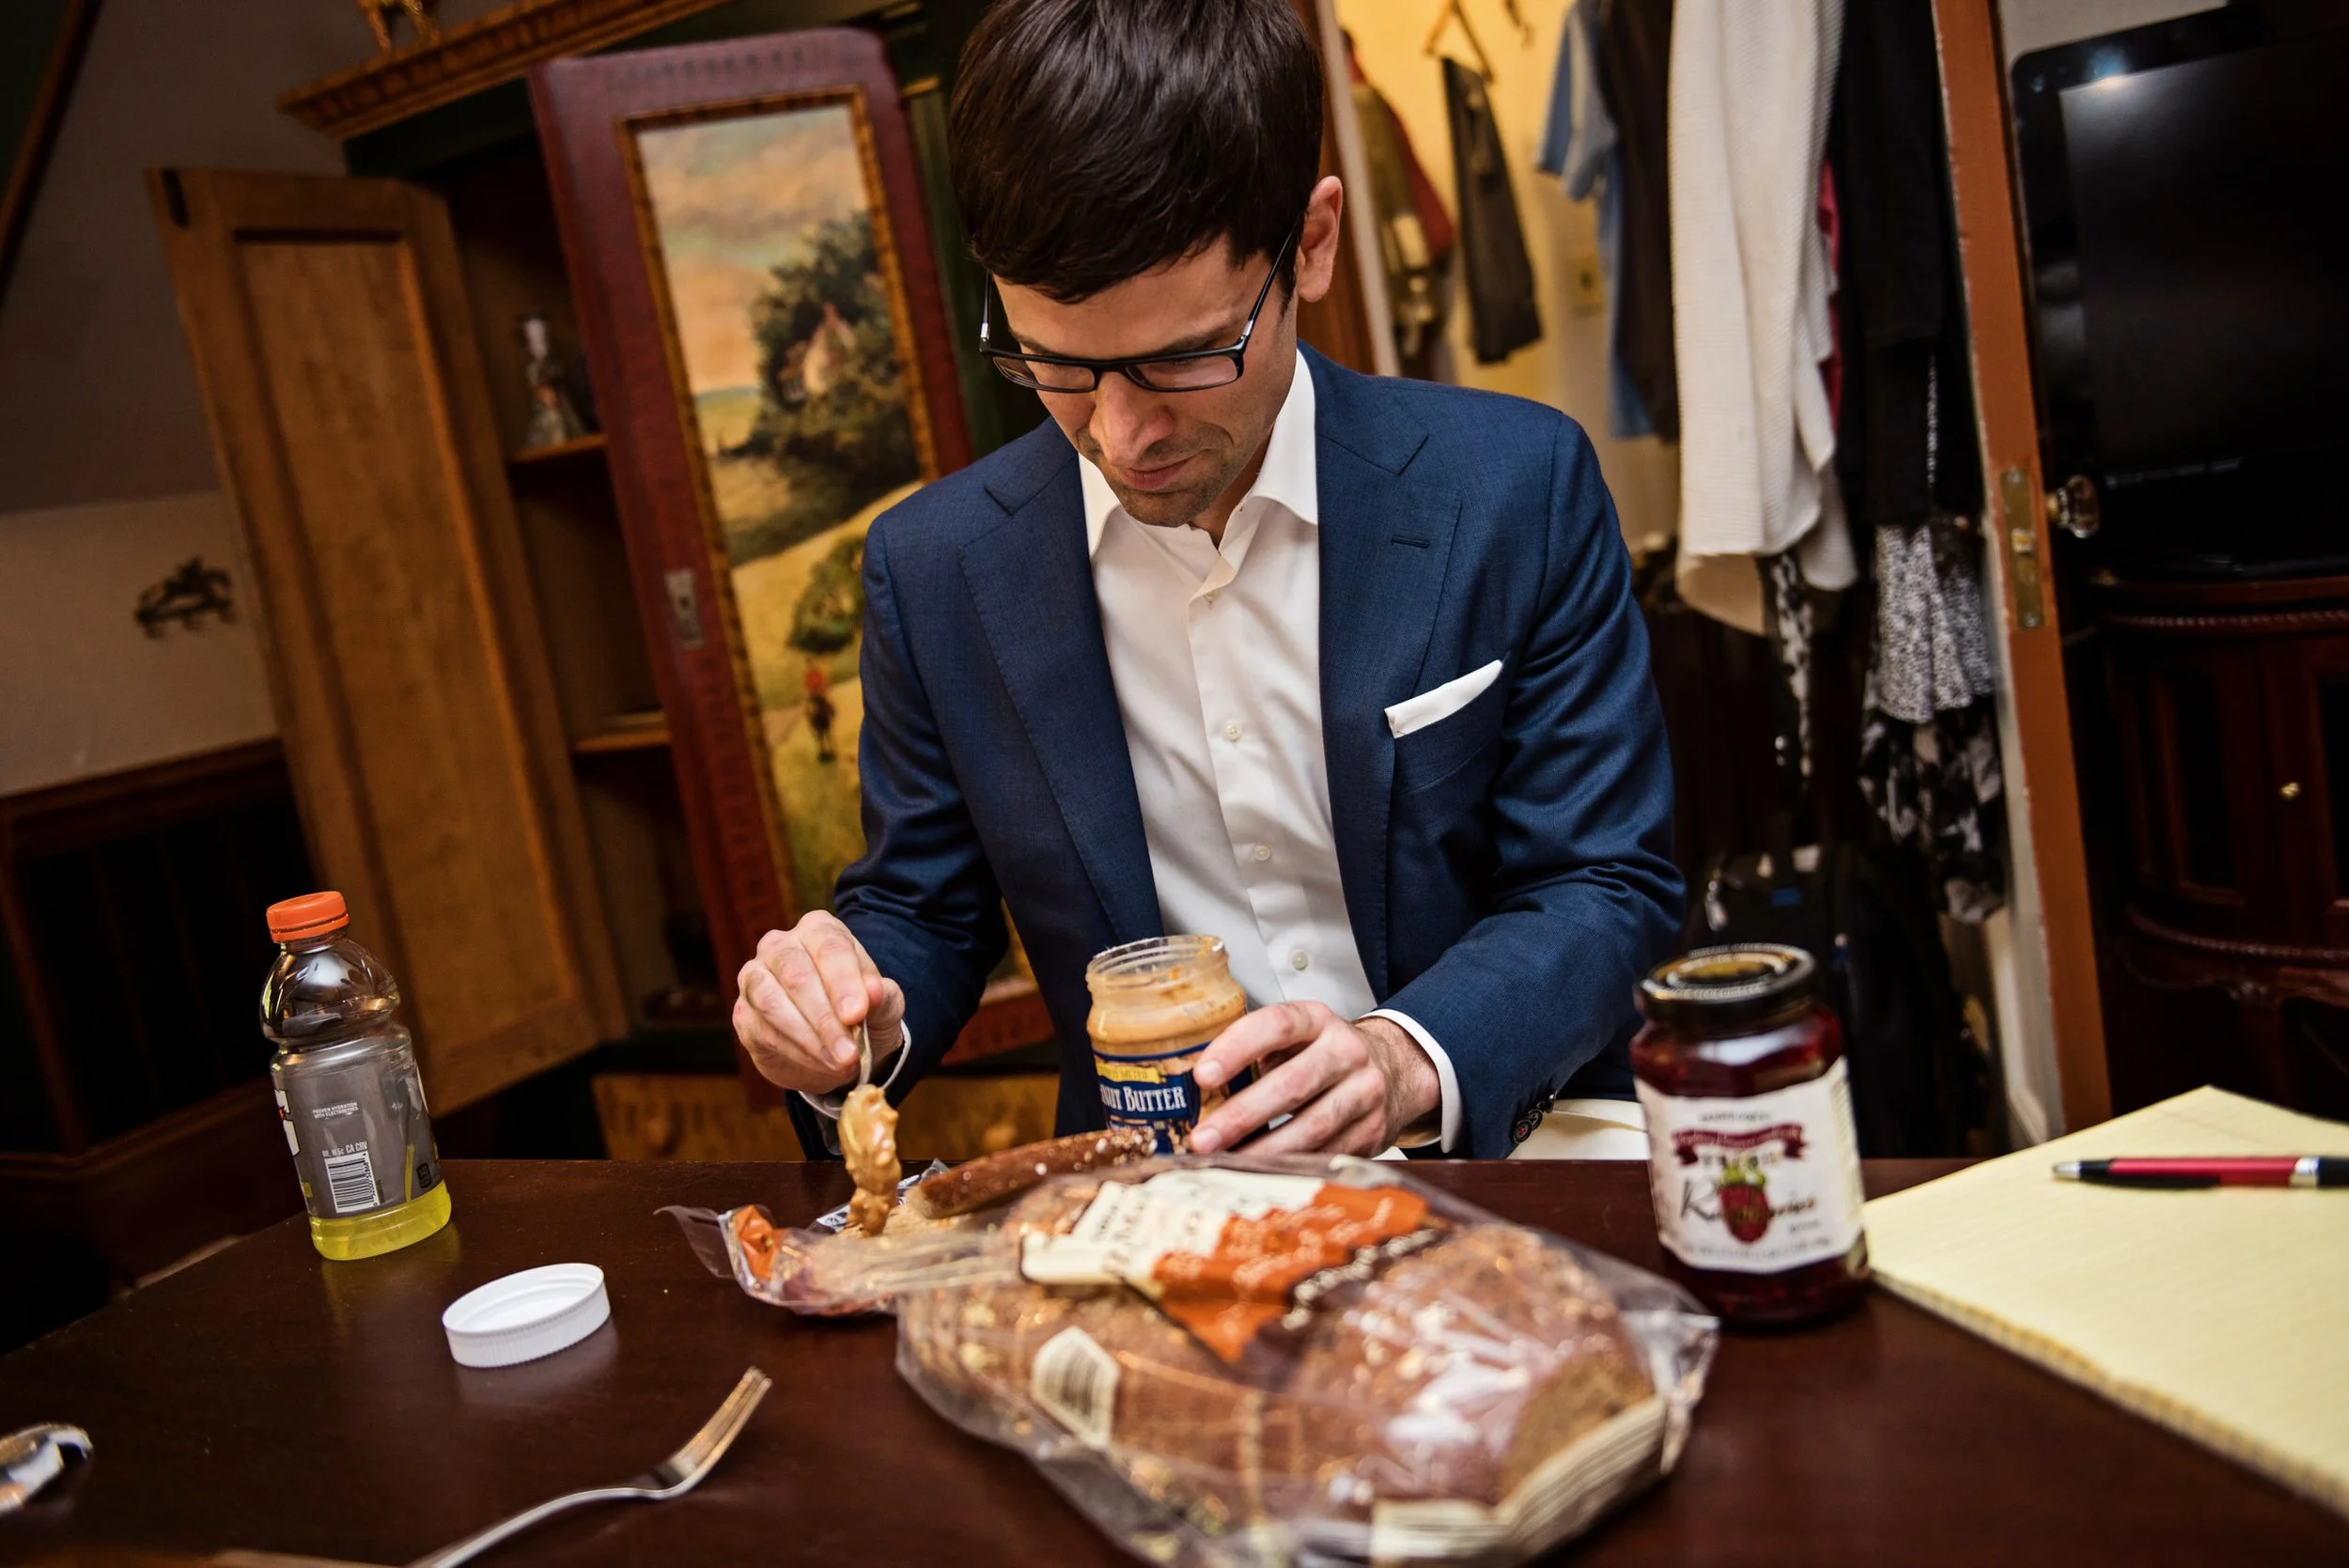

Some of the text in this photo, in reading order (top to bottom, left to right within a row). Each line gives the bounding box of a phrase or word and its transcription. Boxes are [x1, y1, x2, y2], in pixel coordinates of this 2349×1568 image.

[1123, 1085, 1187, 1112] BUTTER
[331, 1102, 357, 1110] HYDRATION
[345, 1143, 355, 1154] CA
[354, 1141, 367, 1152] CRV
